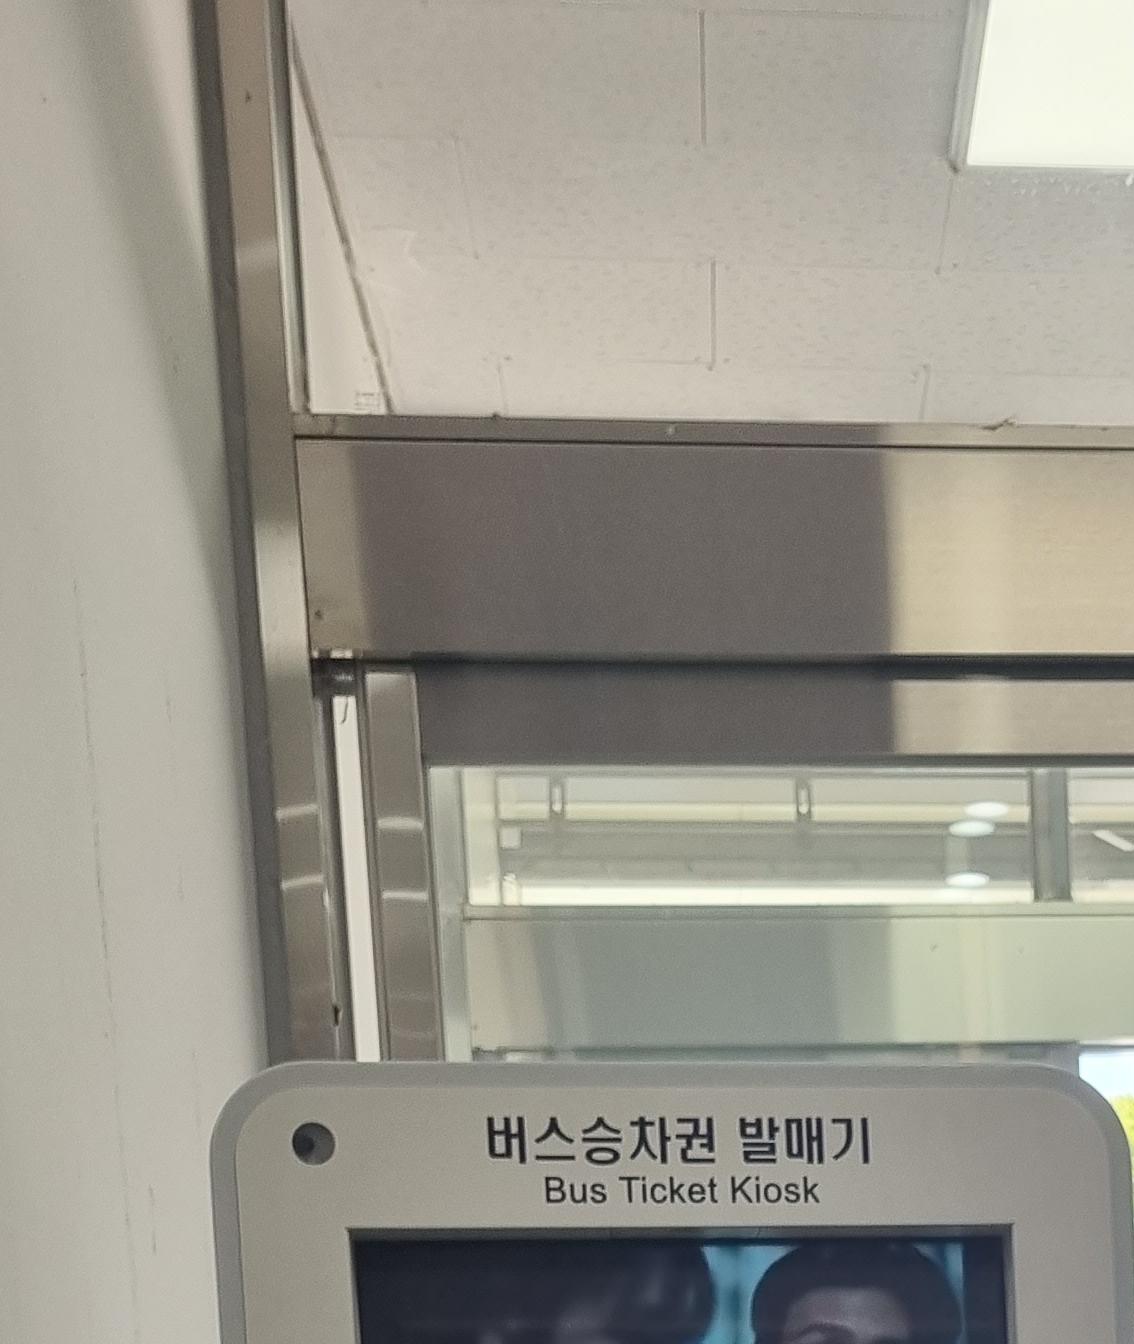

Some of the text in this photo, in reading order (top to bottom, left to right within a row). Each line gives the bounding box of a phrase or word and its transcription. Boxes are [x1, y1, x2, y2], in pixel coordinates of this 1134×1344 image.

[485, 1115, 872, 1166] 버스승차권 발매기
[544, 1175, 821, 1204] Bus Ticket Kiosk
